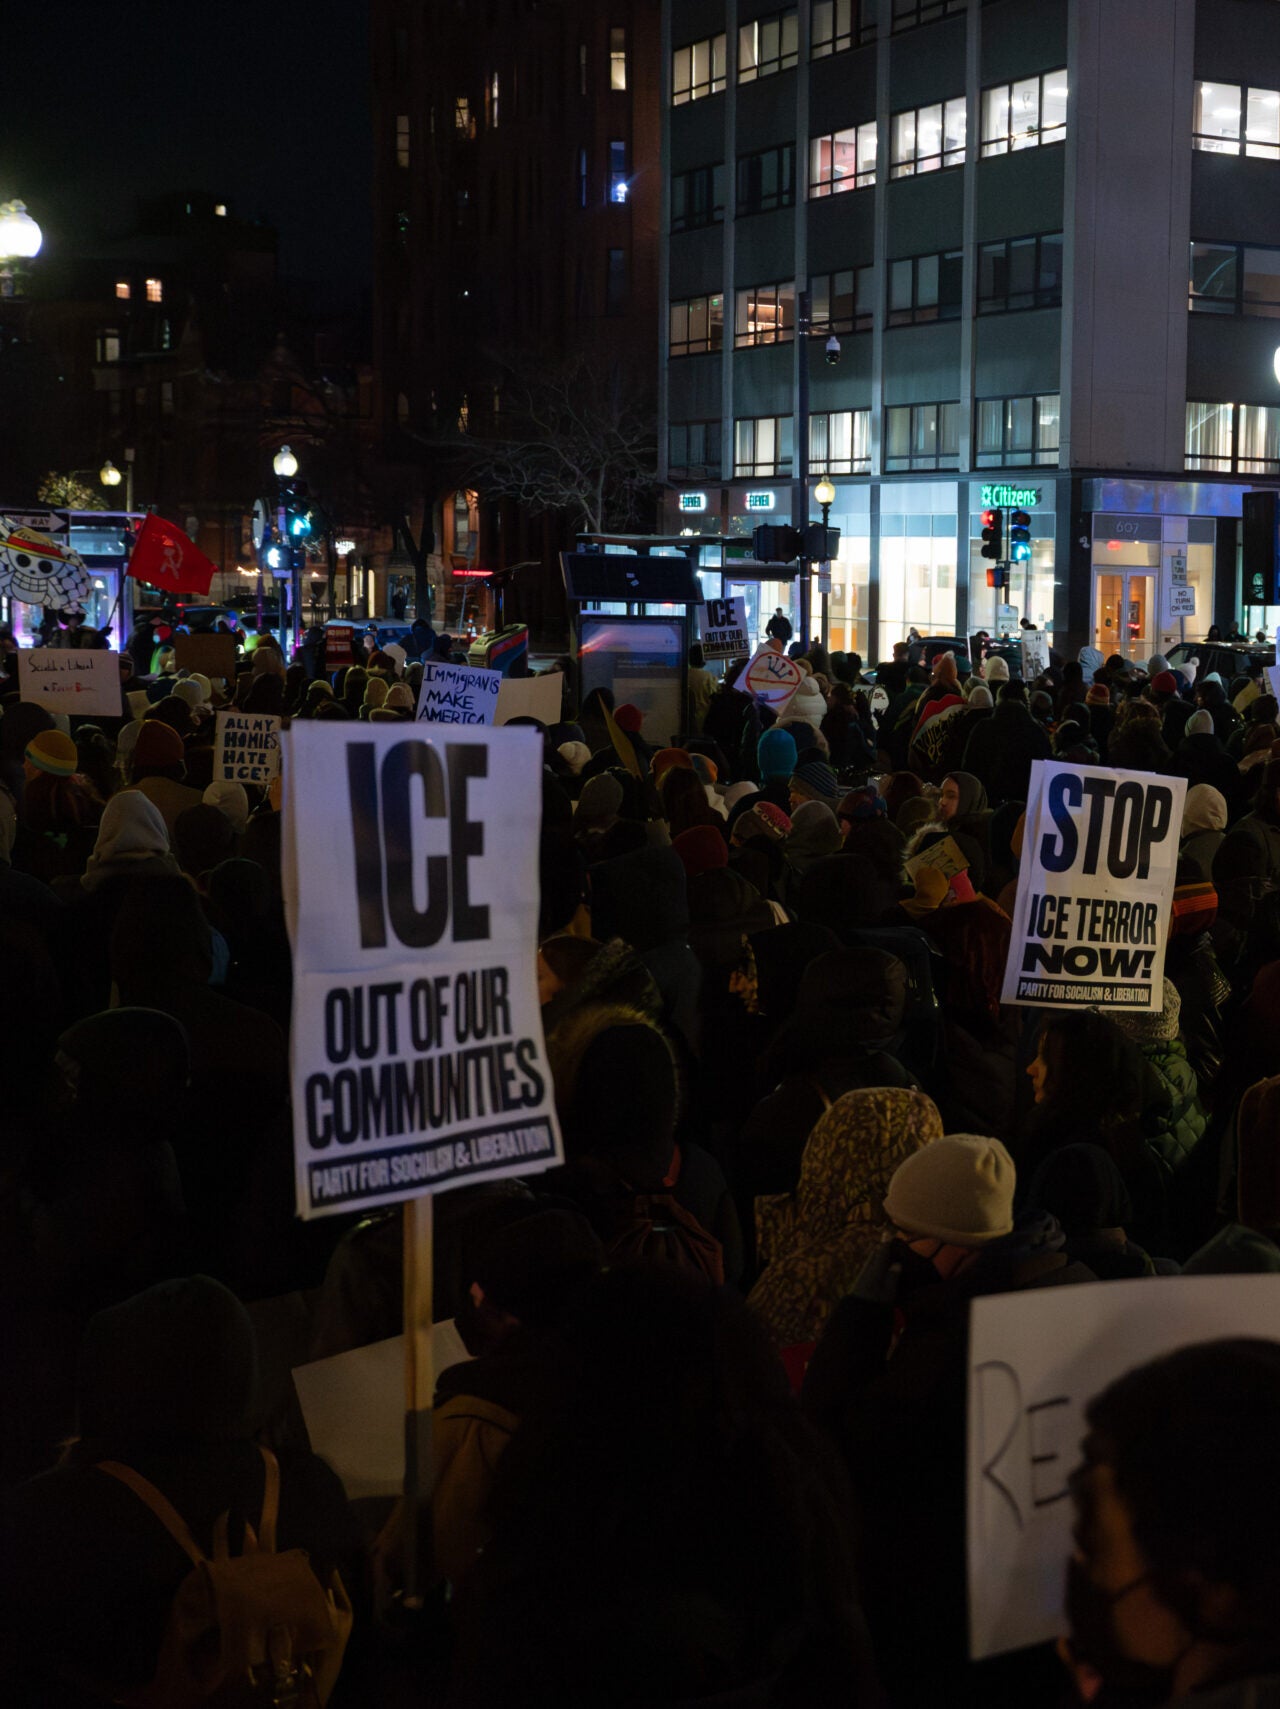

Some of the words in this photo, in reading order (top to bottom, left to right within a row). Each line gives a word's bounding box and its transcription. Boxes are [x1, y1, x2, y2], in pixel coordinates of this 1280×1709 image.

[992, 485, 1037, 506] Citizens
[1115, 522, 1140, 535] 607
[706, 598, 737, 627] ICE
[426, 689, 475, 710] MAKE
[224, 717, 249, 730] ALL
[253, 719, 274, 732] MY
[418, 704, 485, 725] AMERICA
[224, 731, 279, 750] HOMIES
[222, 749, 267, 765] HATE
[224, 765, 270, 782] ICE!
[1040, 772, 1173, 880] STOP
[346, 739, 490, 950] ICE
[1027, 894, 1072, 940] ICE
[1076, 897, 1158, 946] TERROR
[1021, 941, 1157, 979] NOW!
[1019, 981, 1048, 998] PARTY
[1048, 983, 1066, 1000] FOR
[1065, 984, 1104, 1001] SOCIALISM
[1103, 987, 1113, 1002] &
[1112, 987, 1150, 1003] LIBERATION
[325, 981, 403, 1064] OUT
[410, 976, 449, 1052] OF
[455, 966, 513, 1044] OUR
[305, 1037, 545, 1150] COMMUNITIES
[311, 1165, 359, 1200] PARTY
[359, 1157, 390, 1190] FOR
[454, 1137, 472, 1168] &
